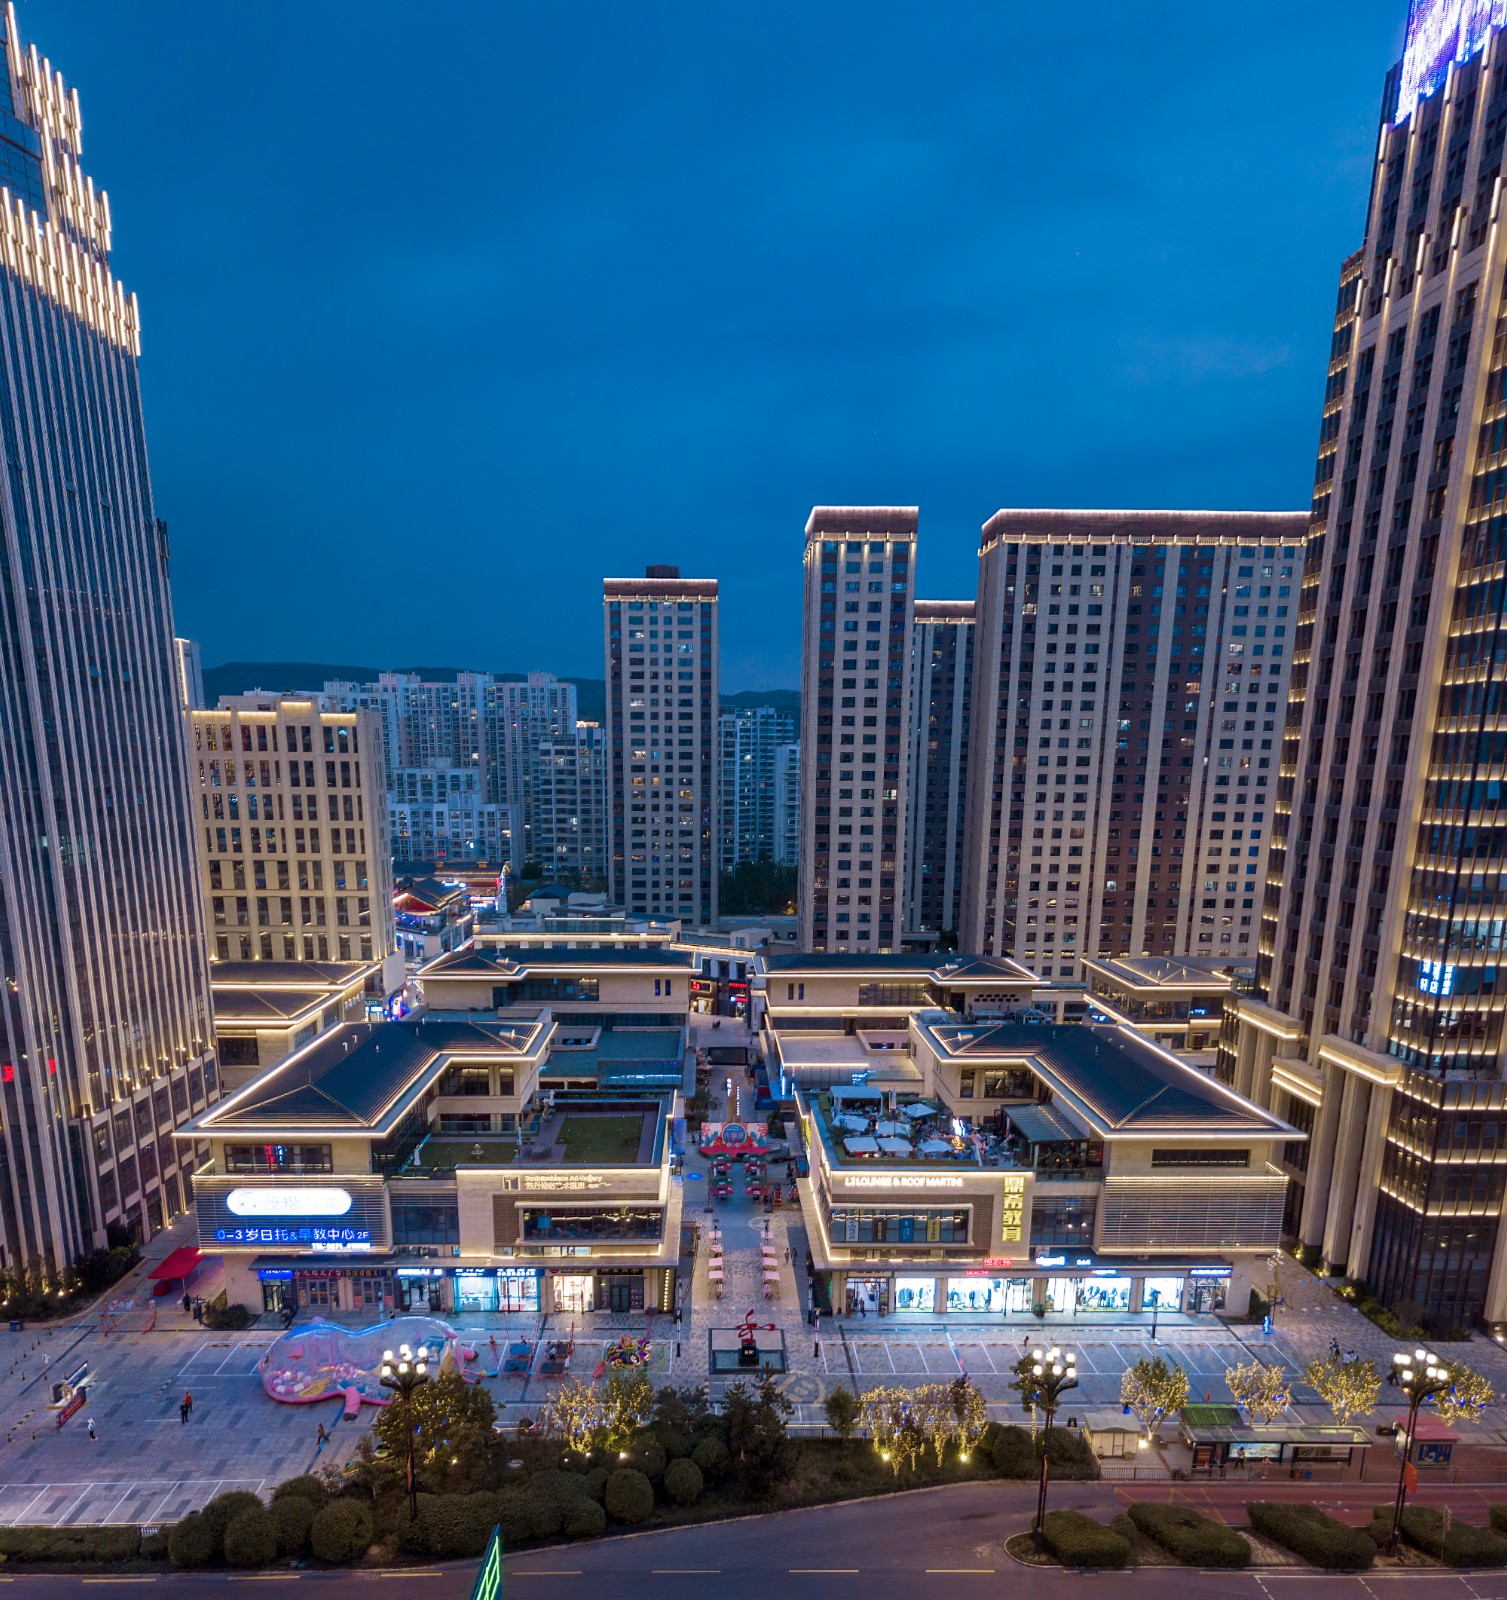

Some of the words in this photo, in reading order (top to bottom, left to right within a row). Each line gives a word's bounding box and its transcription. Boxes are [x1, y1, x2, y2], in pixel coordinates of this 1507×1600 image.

[855, 1176, 892, 1187] LOUNGE
[901, 1176, 926, 1187] ROOF
[926, 1176, 963, 1187] MARTINI
[1001, 1176, 1025, 1242] 鼎希教育
